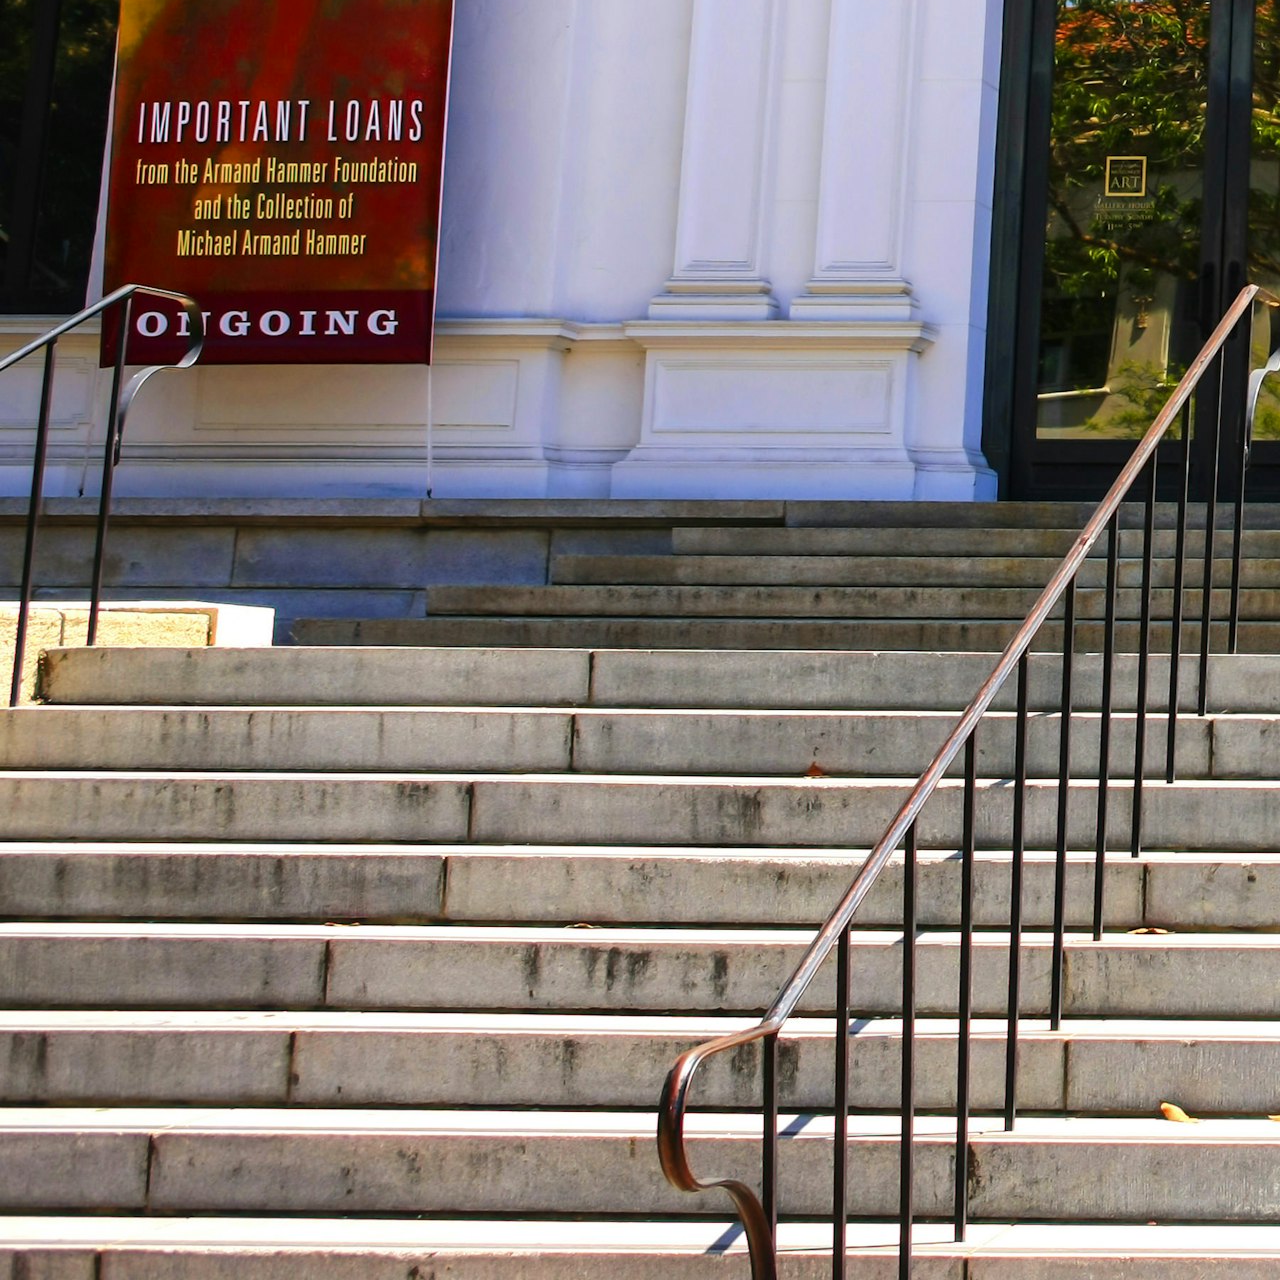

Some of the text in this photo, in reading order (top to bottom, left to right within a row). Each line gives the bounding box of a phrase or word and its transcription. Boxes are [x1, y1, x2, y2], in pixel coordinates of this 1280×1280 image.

[138, 99, 423, 143] IMPORTANT LOANS
[136, 156, 418, 185] from the Armand Hammer Foundation
[1111, 176, 1141, 189] ART
[195, 193, 354, 220] and the Collection of
[177, 229, 367, 257] Michael Armand Hammer
[136, 310, 399, 337] ONGOING
